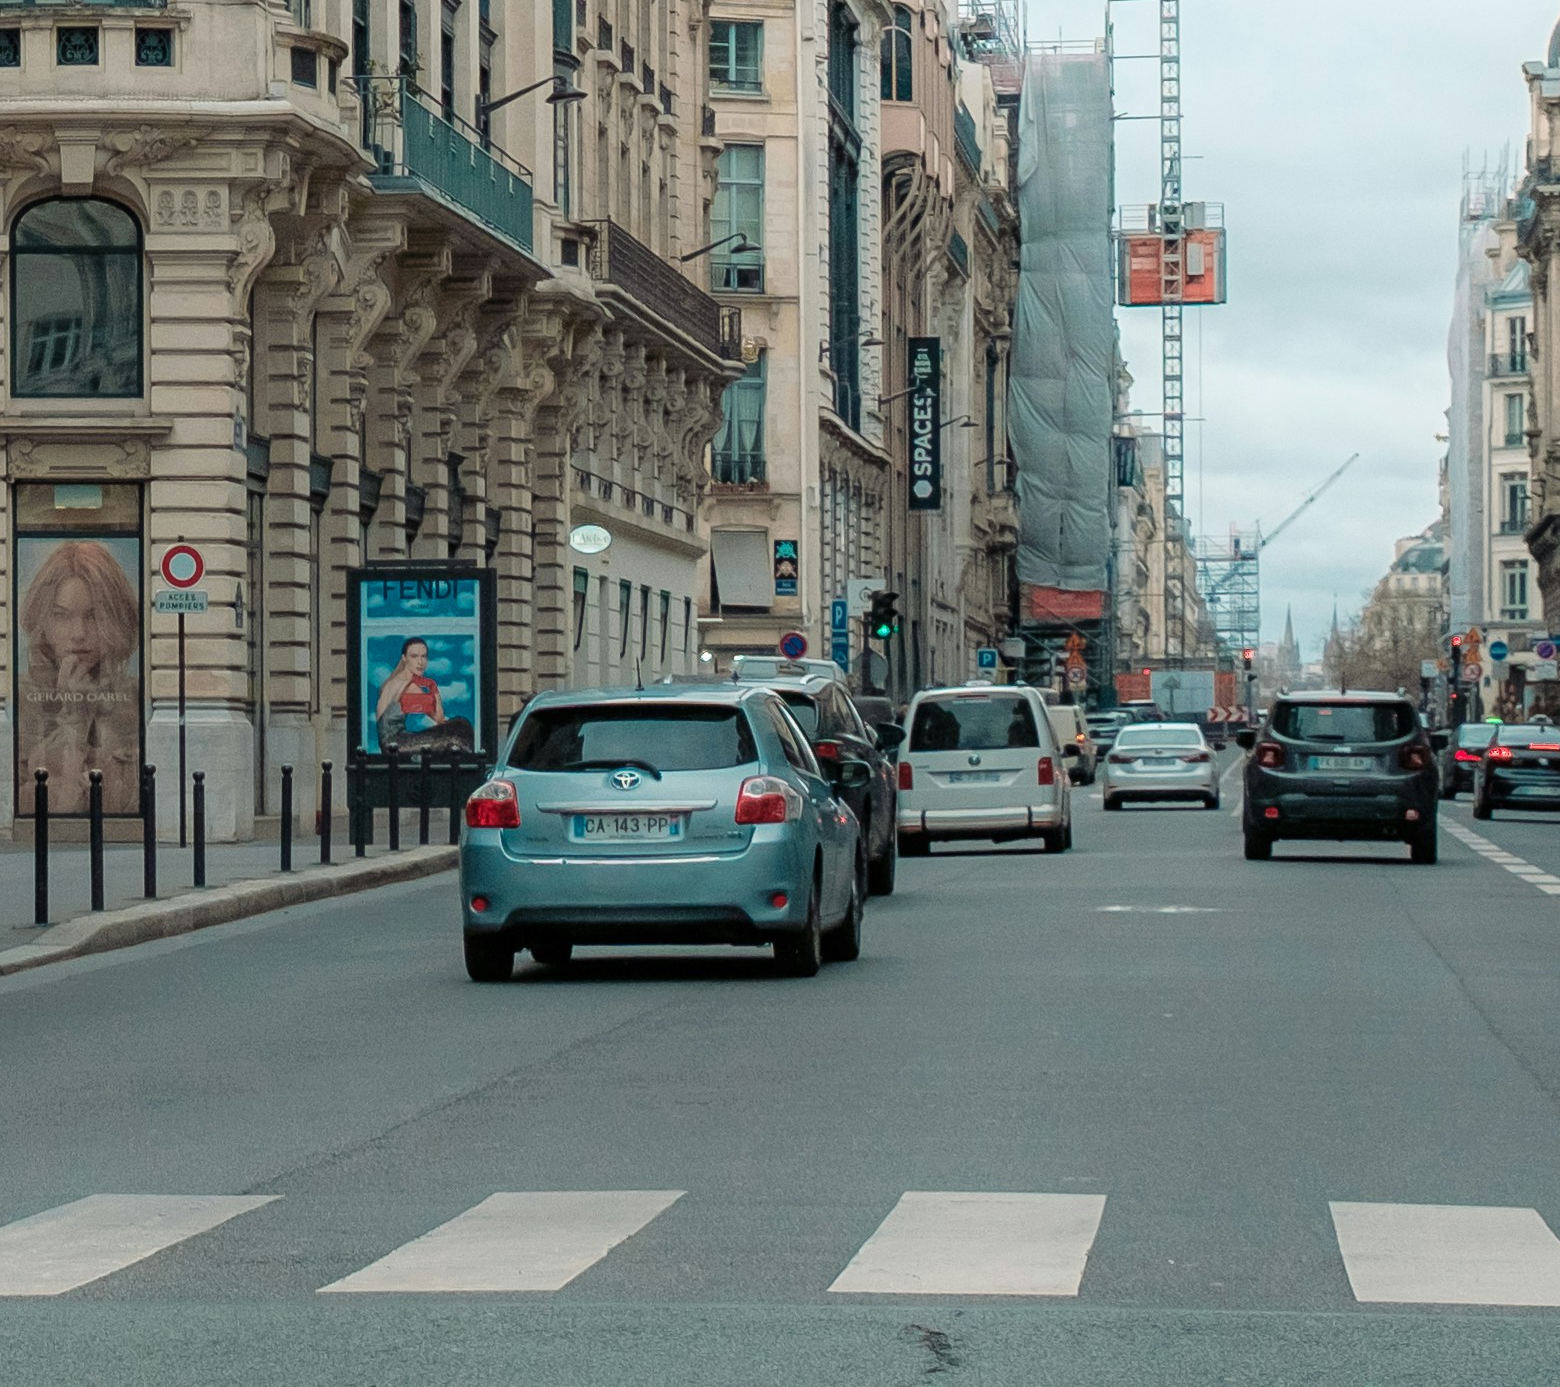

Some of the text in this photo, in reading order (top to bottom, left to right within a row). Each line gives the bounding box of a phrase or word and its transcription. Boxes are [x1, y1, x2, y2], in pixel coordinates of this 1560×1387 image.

[913, 393, 933, 476] SPACES
[383, 579, 458, 600] FENDI
[168, 591, 196, 601] ACCÈS
[159, 601, 205, 611] POMPIERS
[26, 691, 131, 702] GERARD DAREL
